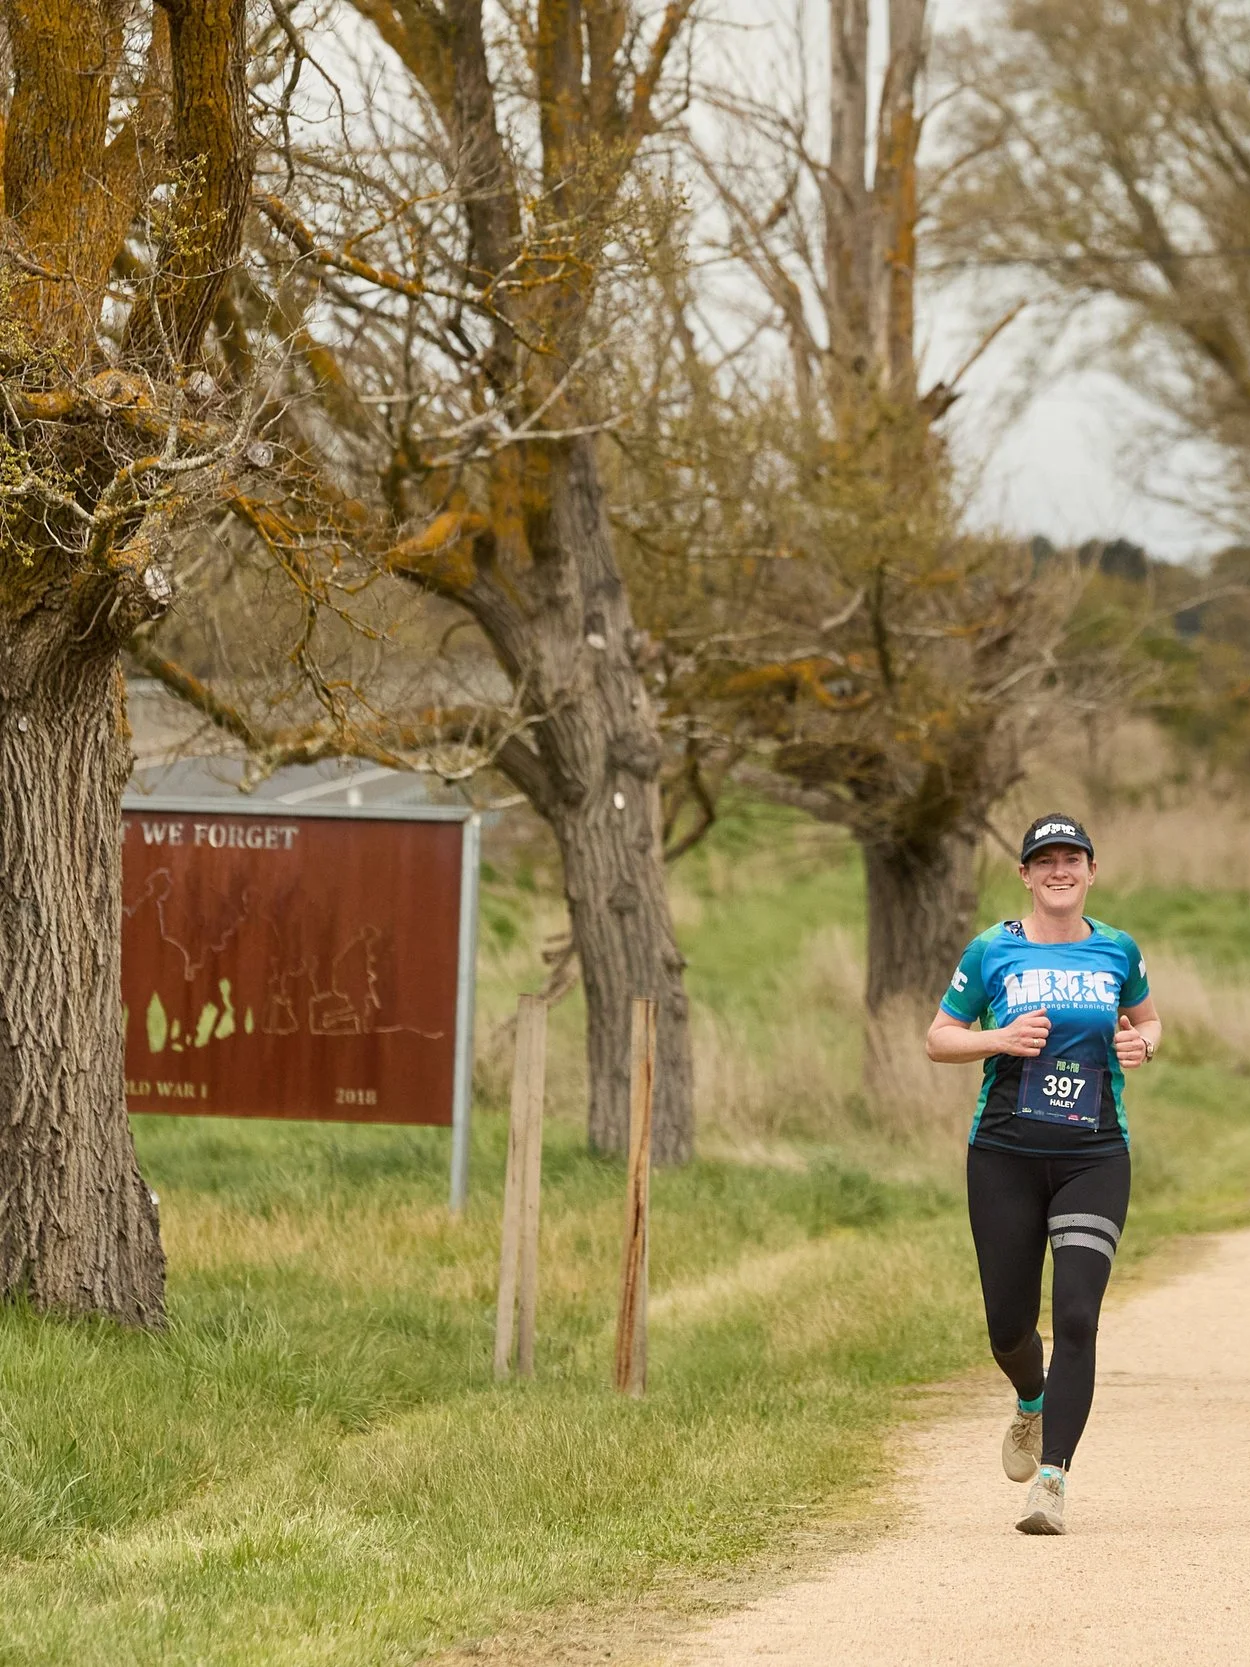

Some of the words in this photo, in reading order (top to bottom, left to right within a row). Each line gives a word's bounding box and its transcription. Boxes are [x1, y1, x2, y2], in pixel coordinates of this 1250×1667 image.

[141, 821, 184, 846] WE
[194, 822, 299, 849] FORGET
[1004, 968, 1116, 1007] MRRC
[1007, 1004, 1038, 1015] Macedon
[1040, 1002, 1070, 1011] Ranges
[1073, 1002, 1105, 1011] Running
[156, 1080, 195, 1098] WAR
[335, 1087, 378, 1105] 2018
[1042, 1074, 1086, 1100] 397
[1049, 1098, 1076, 1109] HALEY
